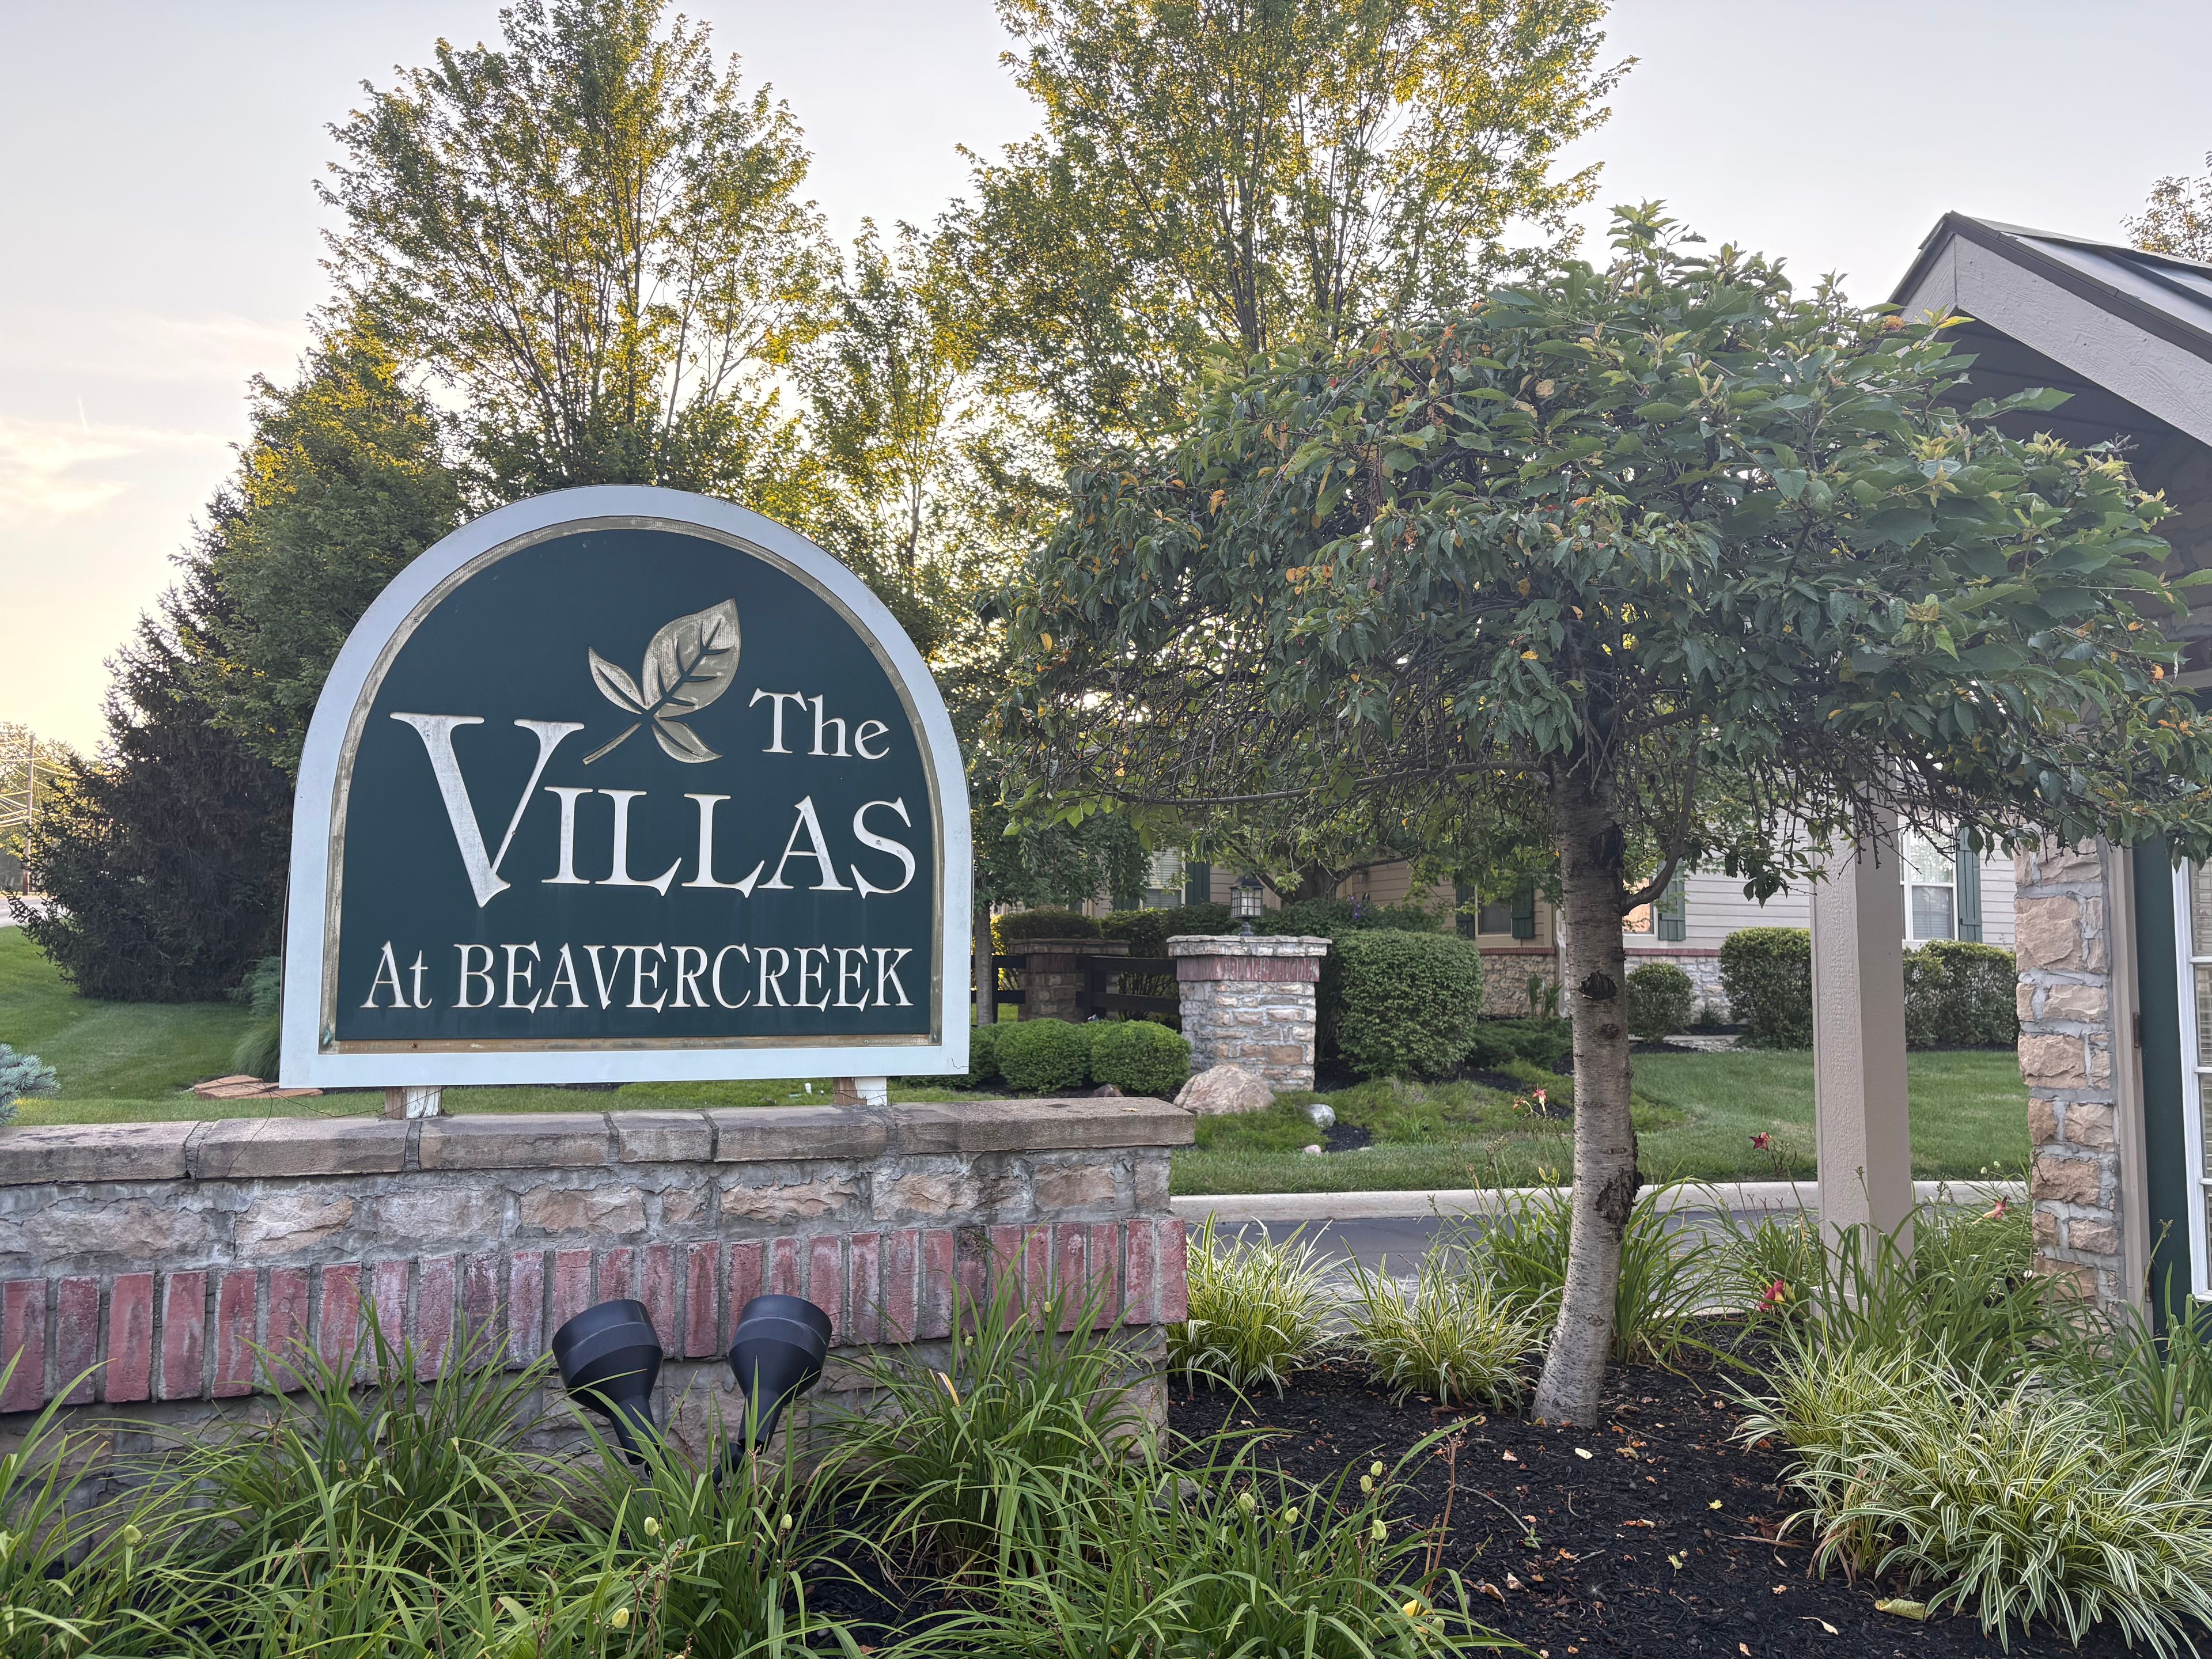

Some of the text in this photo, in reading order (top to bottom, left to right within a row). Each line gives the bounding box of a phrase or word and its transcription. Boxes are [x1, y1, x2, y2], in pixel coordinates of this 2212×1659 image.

[749, 688, 890, 760] The
[389, 711, 916, 908] VILLAS
[359, 940, 914, 1014] At BEAVERCREEK
